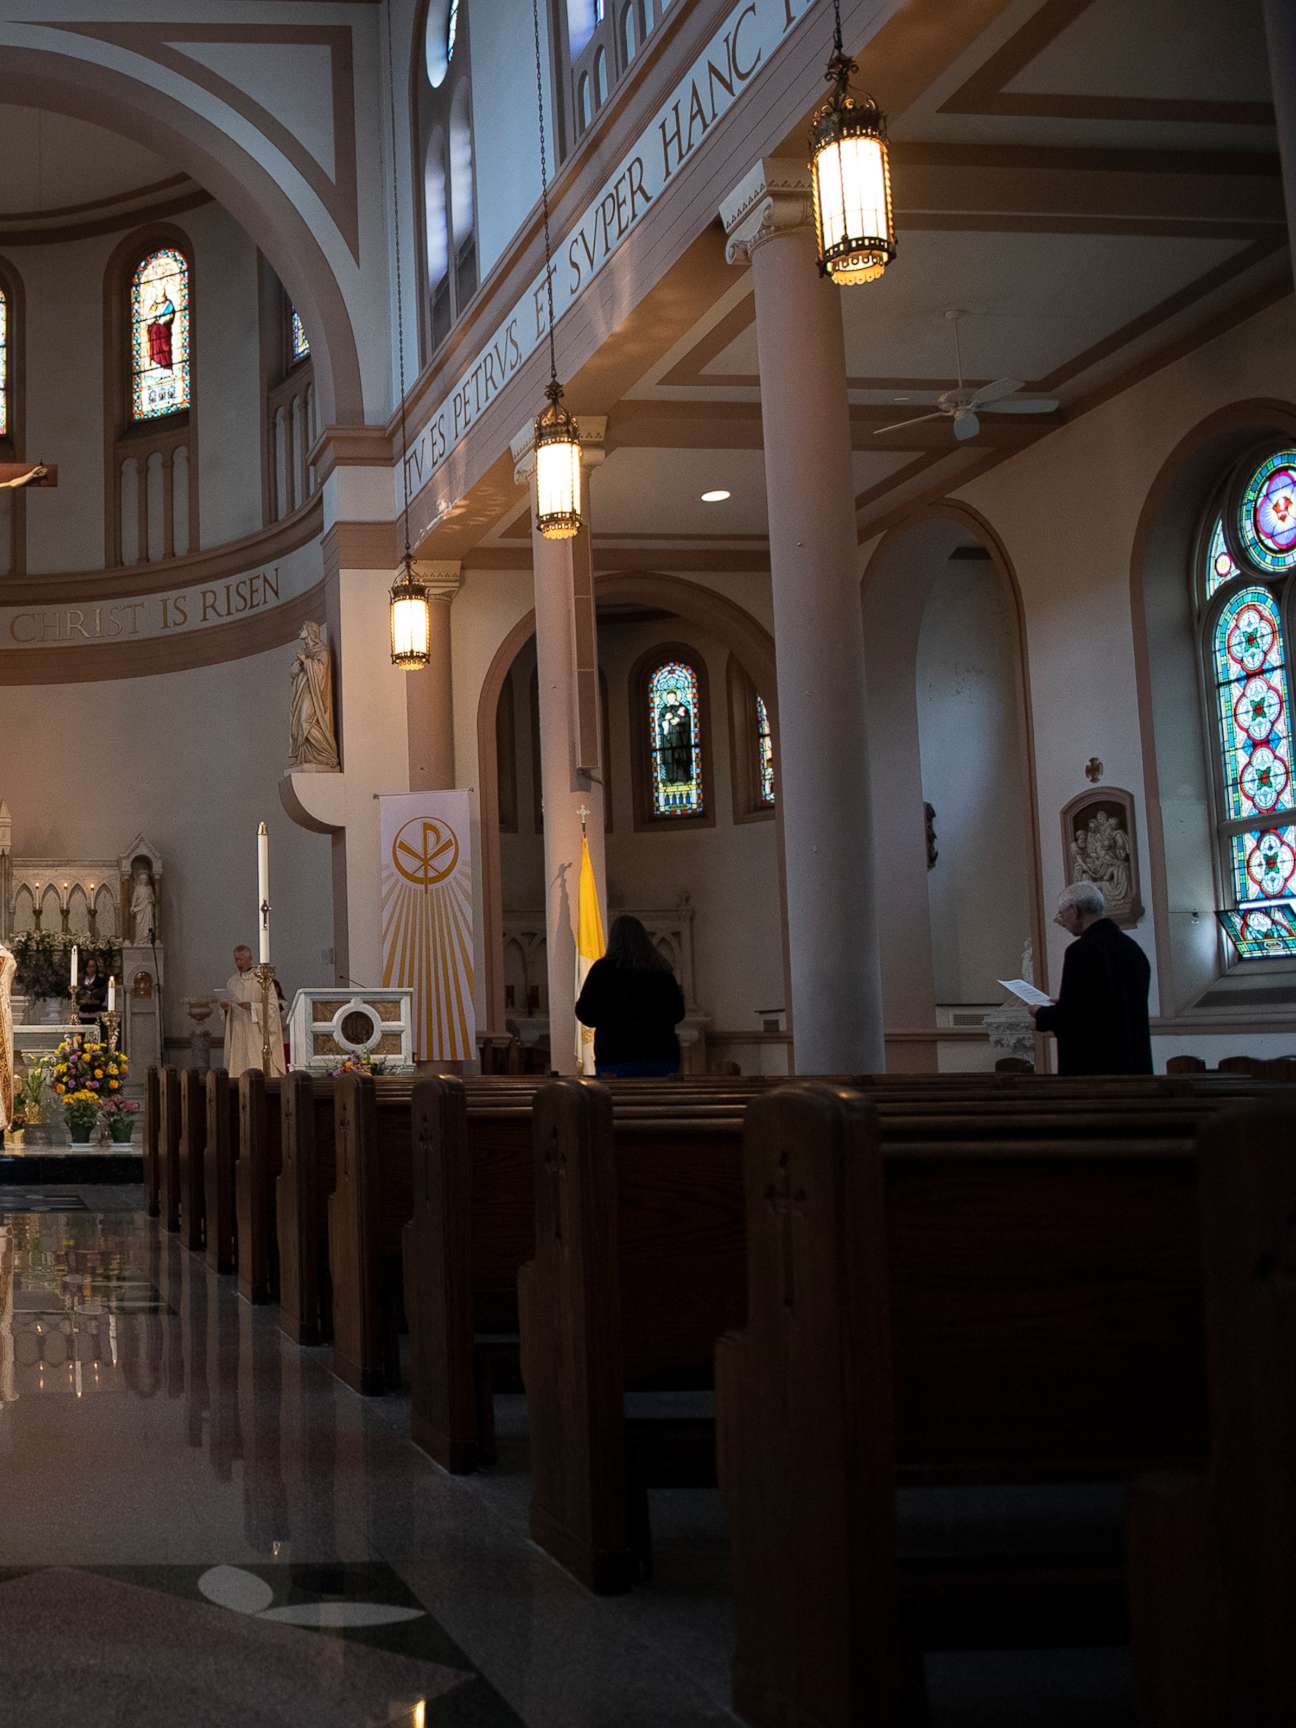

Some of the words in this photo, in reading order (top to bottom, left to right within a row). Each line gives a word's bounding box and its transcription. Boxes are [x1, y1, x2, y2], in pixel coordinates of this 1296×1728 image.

[430, 414, 446, 468] ES
[569, 156, 653, 295] SVPER
[658, 6, 761, 182] HANC
[10, 602, 144, 643] CHRIST
[160, 595, 188, 630] IS
[200, 567, 280, 622] RISEN
